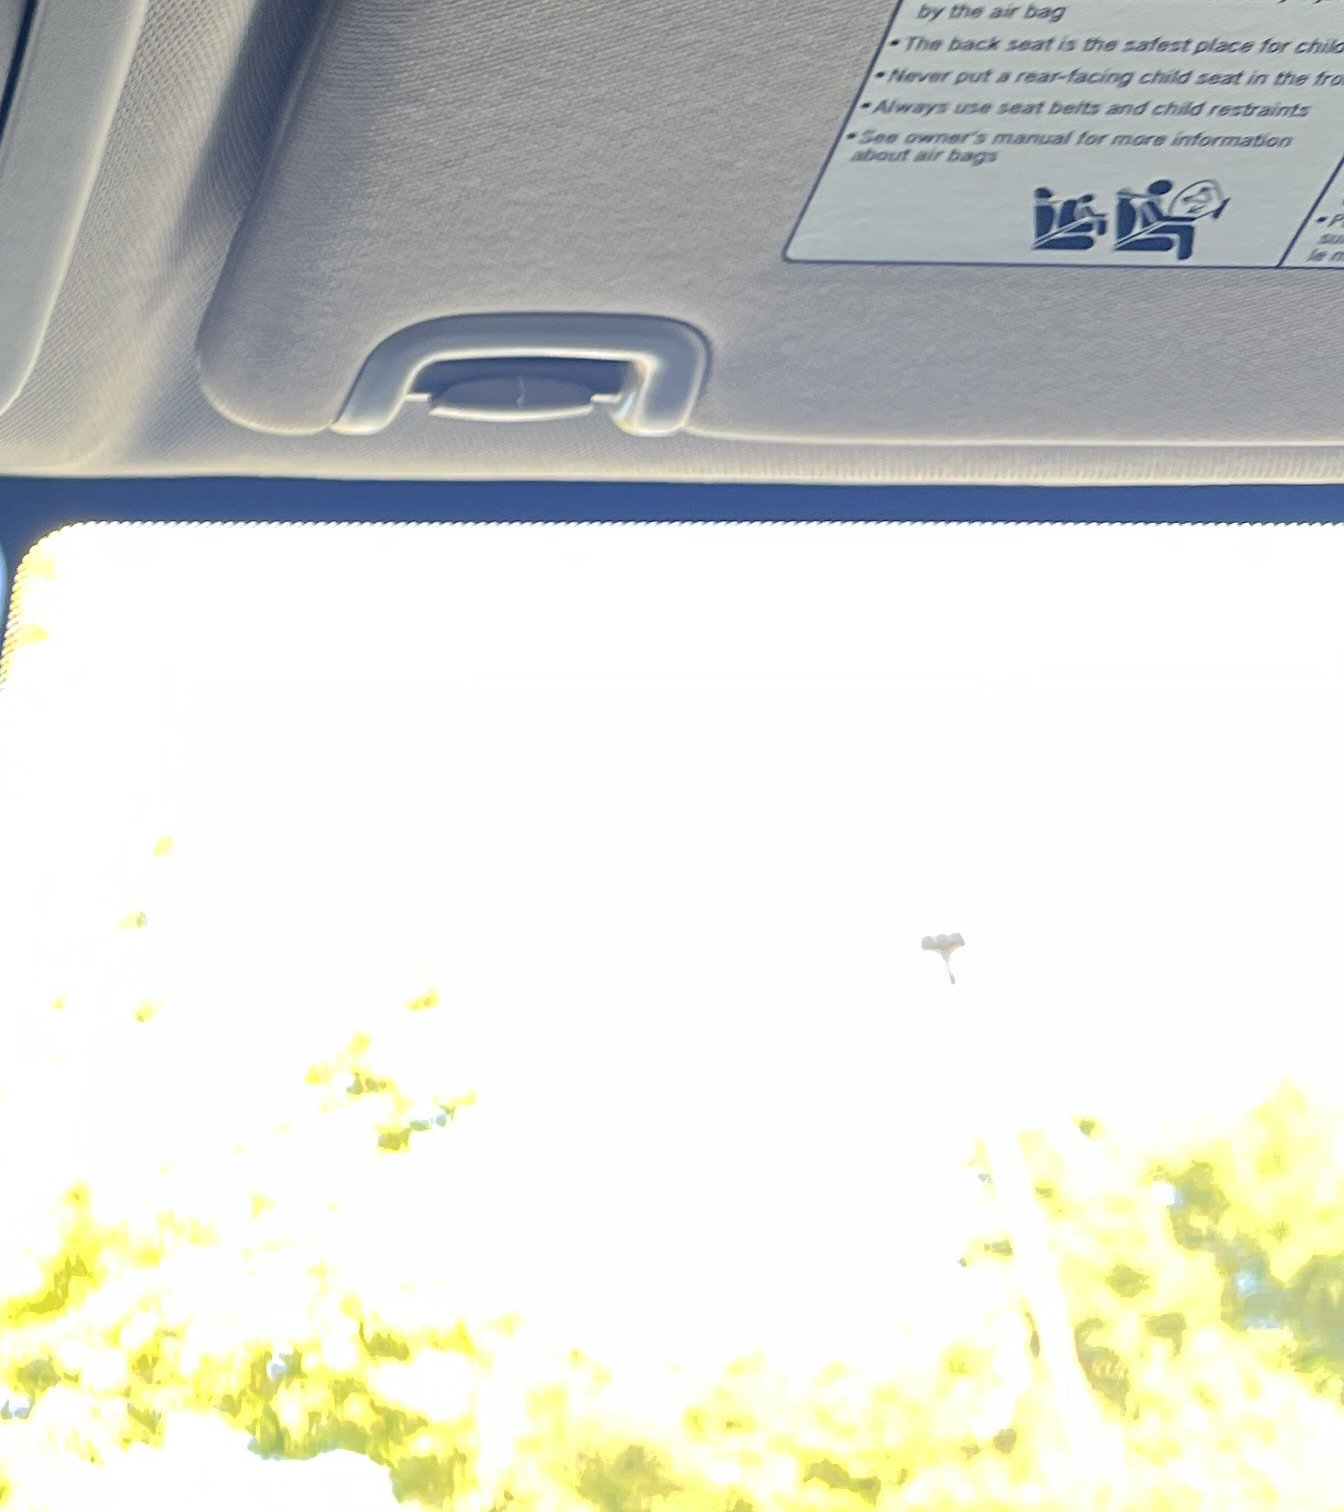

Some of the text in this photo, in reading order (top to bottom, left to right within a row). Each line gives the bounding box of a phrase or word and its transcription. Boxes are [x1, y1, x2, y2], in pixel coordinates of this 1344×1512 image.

[916, 3, 1068, 23] by the air bag
[905, 36, 942, 52] The
[947, 36, 999, 52] back
[1005, 37, 1054, 52] seat
[1056, 36, 1077, 52] is
[1083, 37, 1118, 52] the
[1122, 36, 1192, 53] safest
[1191, 37, 1256, 56] place
[1259, 37, 1293, 54] for
[886, 67, 1344, 88] Never put a rear-facing child seat in the fro
[872, 99, 1312, 118] Always use seat belts and child restraints
[858, 129, 1294, 148] See owner's manual for more information
[850, 148, 999, 167] about air bags
